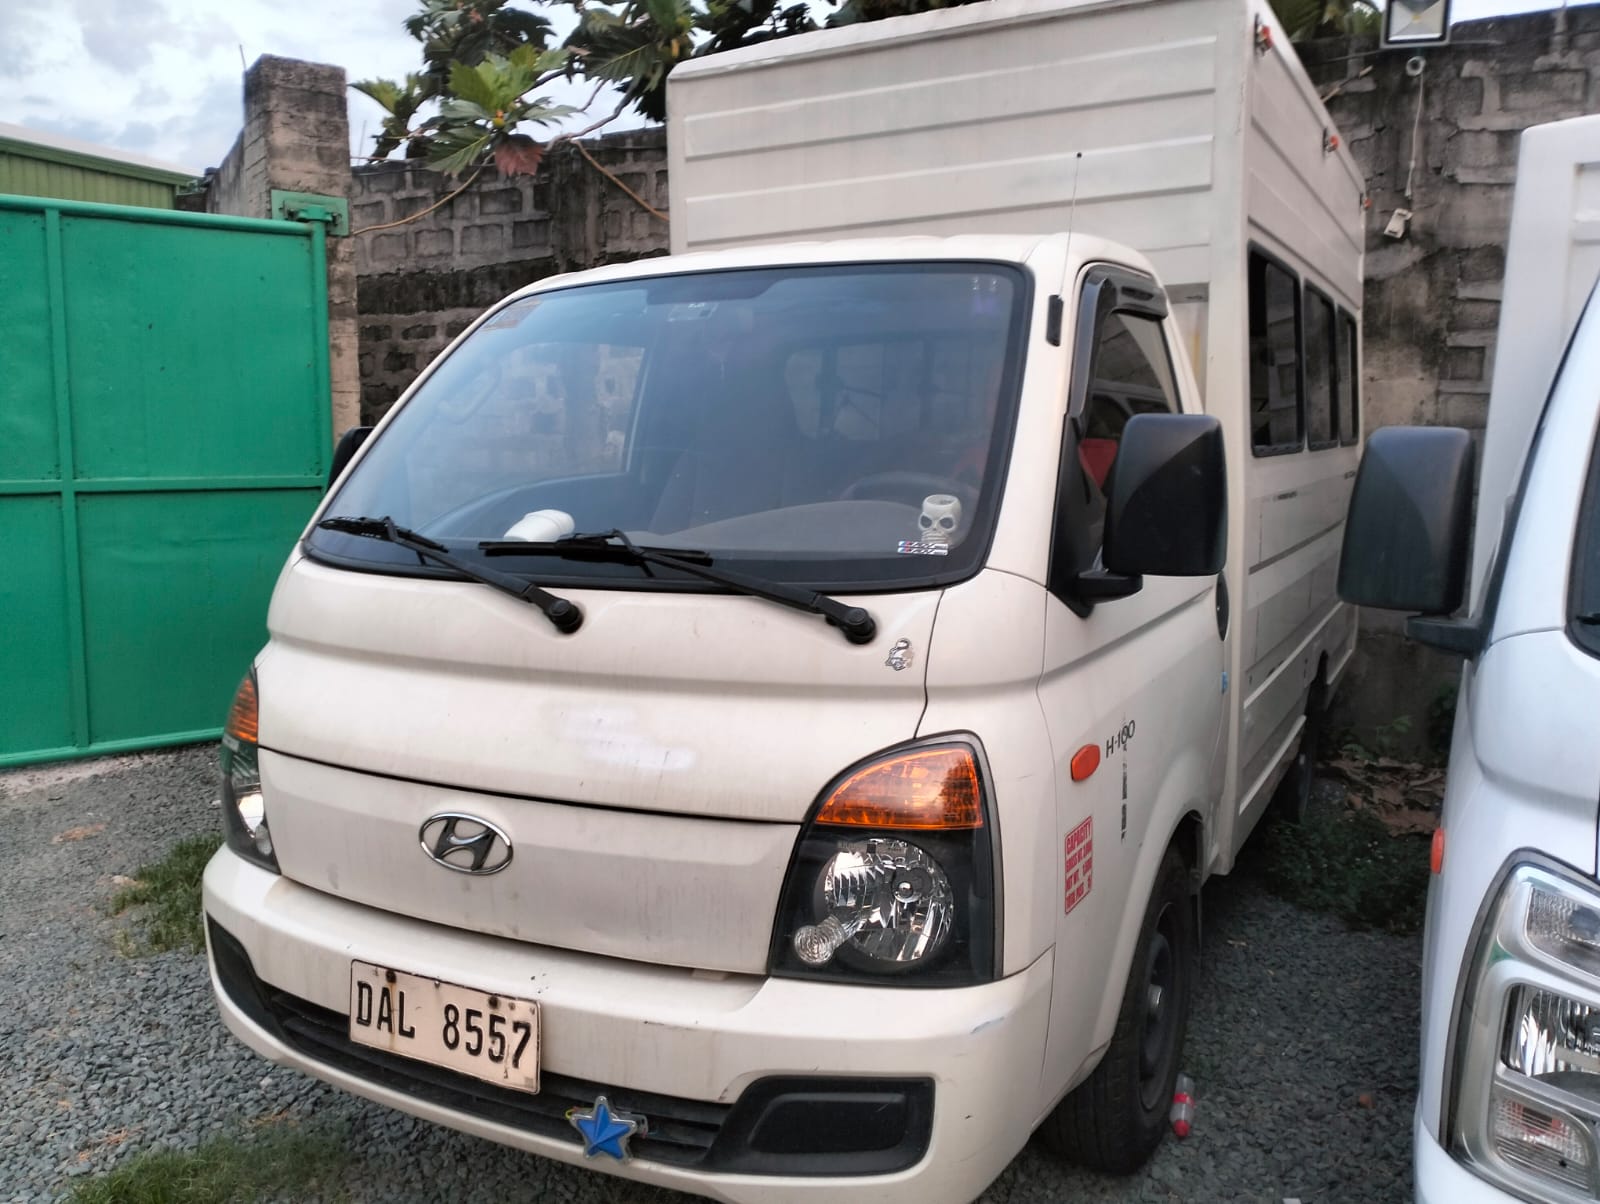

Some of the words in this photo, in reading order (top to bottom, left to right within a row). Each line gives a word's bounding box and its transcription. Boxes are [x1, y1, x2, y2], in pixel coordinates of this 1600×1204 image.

[1106, 720, 1135, 758] H-100
[357, 981, 415, 1039] DAL
[443, 1004, 531, 1069] 8557
